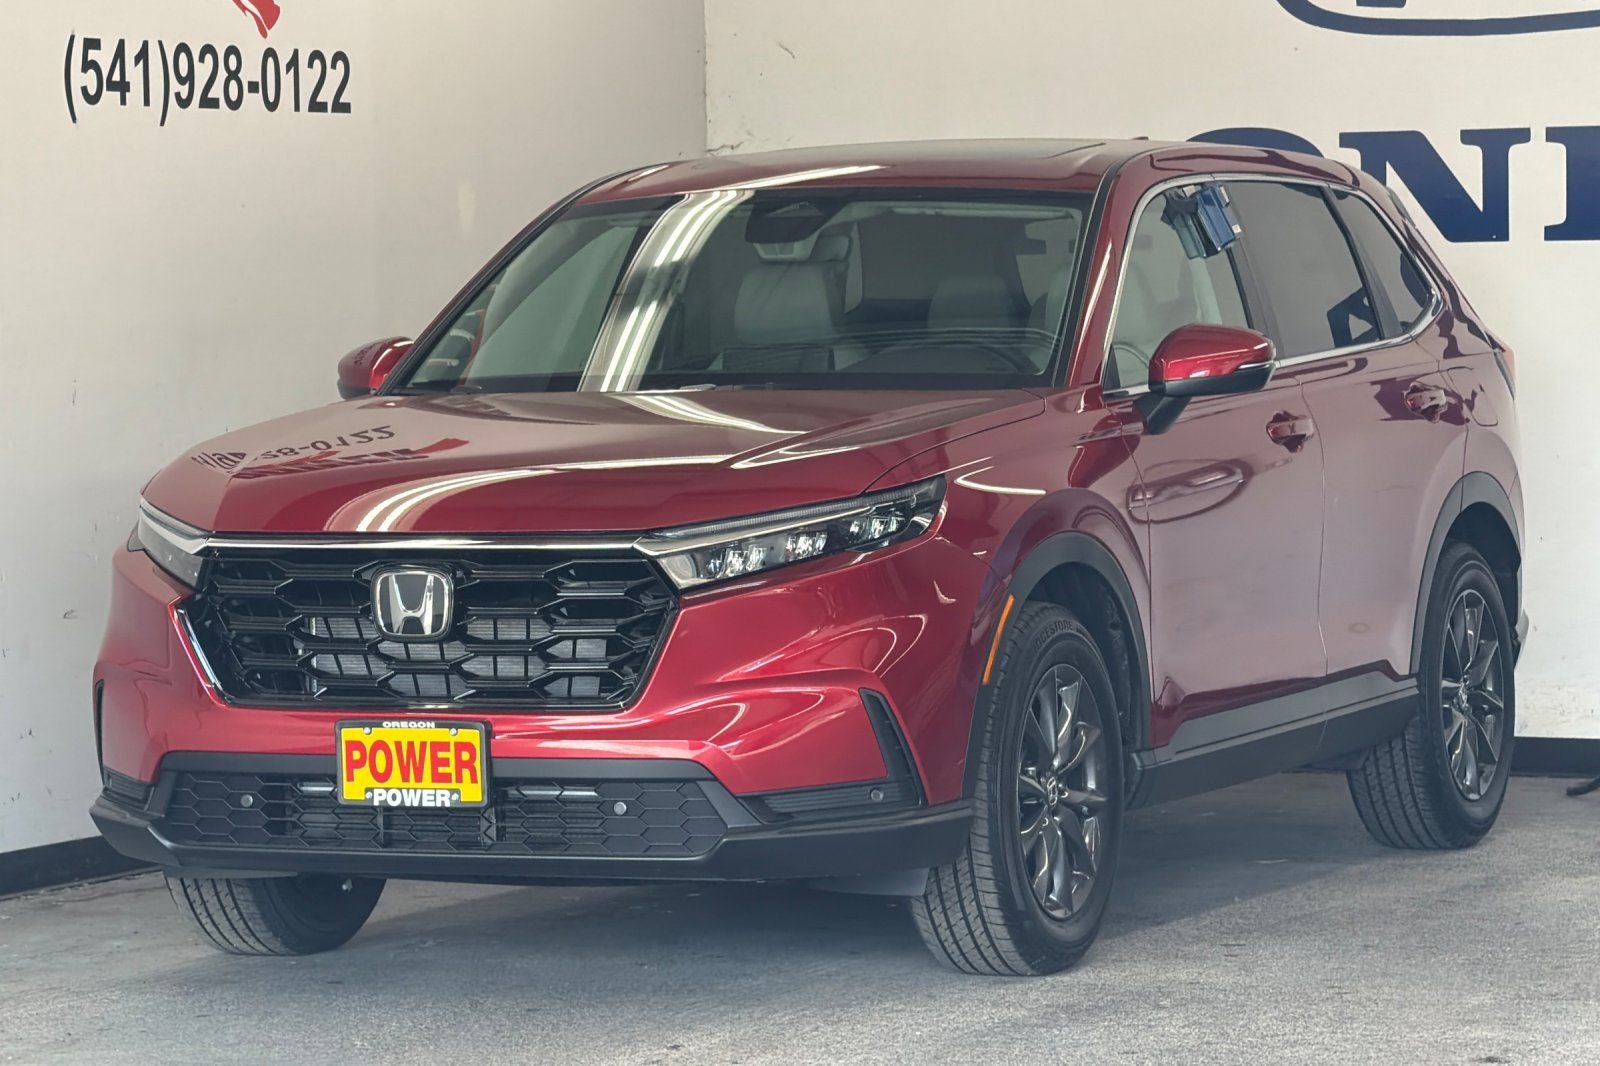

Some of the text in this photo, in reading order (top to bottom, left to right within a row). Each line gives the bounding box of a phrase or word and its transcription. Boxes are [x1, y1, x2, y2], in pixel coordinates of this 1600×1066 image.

[64, 34, 352, 127] (541)928-0122
[382, 721, 436, 729] OREGON
[344, 739, 479, 784] POWER
[373, 788, 451, 808] POWER
